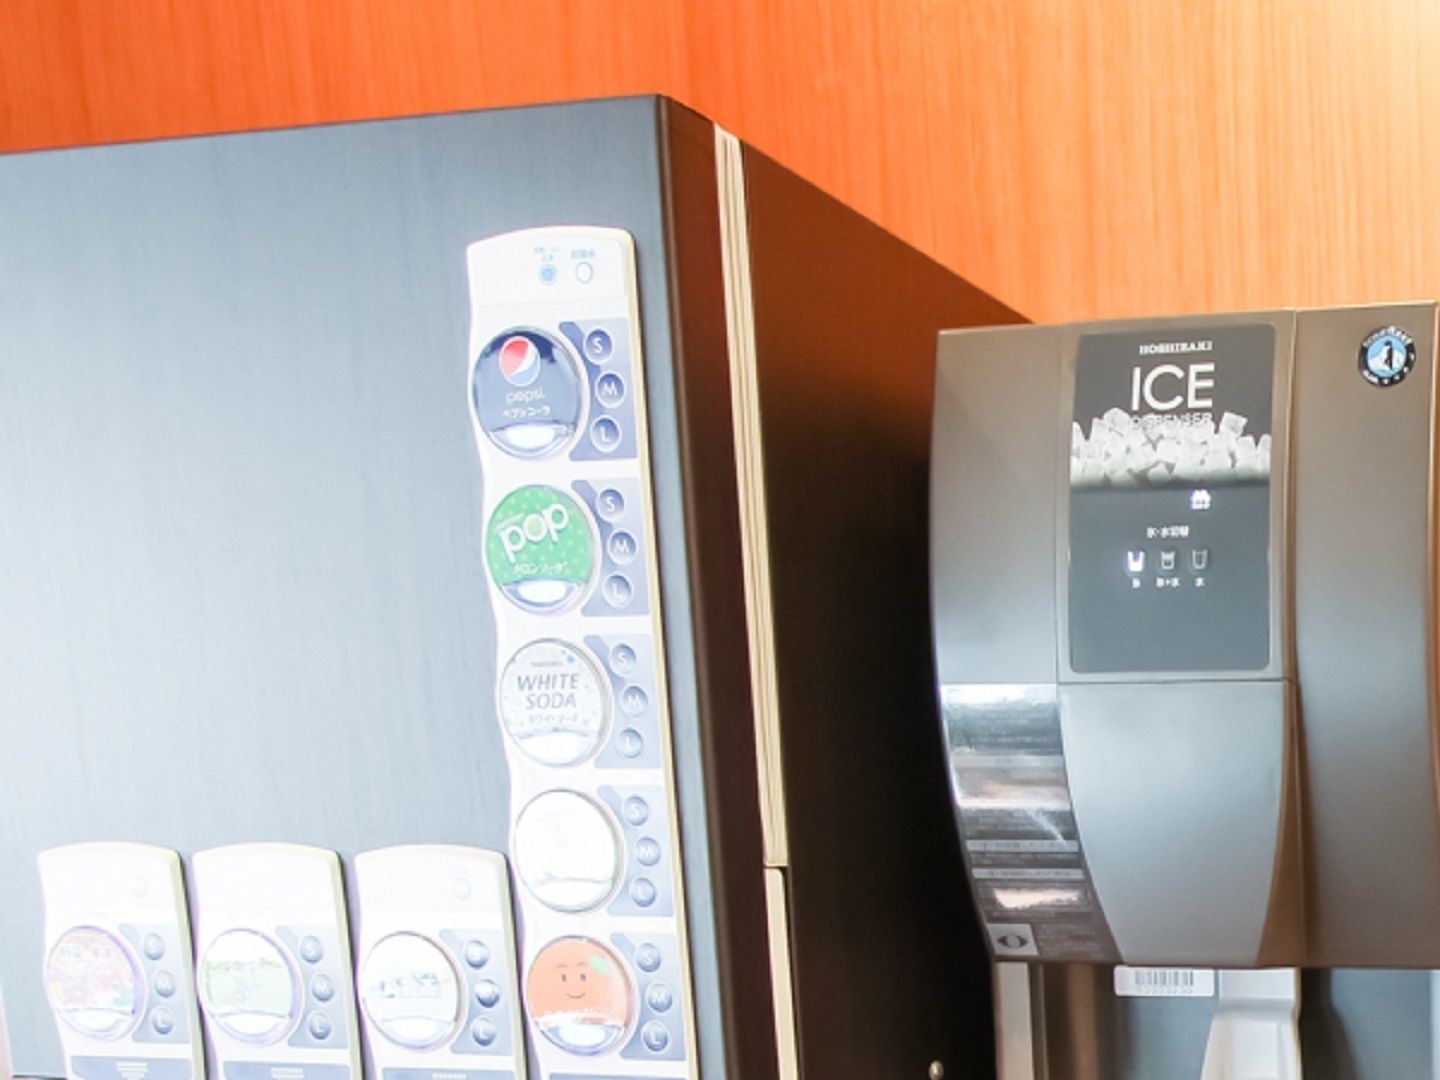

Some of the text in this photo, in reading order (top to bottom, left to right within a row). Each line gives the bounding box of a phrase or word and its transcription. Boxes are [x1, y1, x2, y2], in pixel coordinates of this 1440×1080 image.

[592, 338, 604, 354] S
[603, 382, 617, 397] M
[1131, 363, 1215, 411] ICE
[605, 496, 615, 512] S
[499, 504, 568, 563] pop
[615, 539, 629, 553] M
[517, 672, 580, 692] WHITE
[526, 691, 577, 710] SODA
